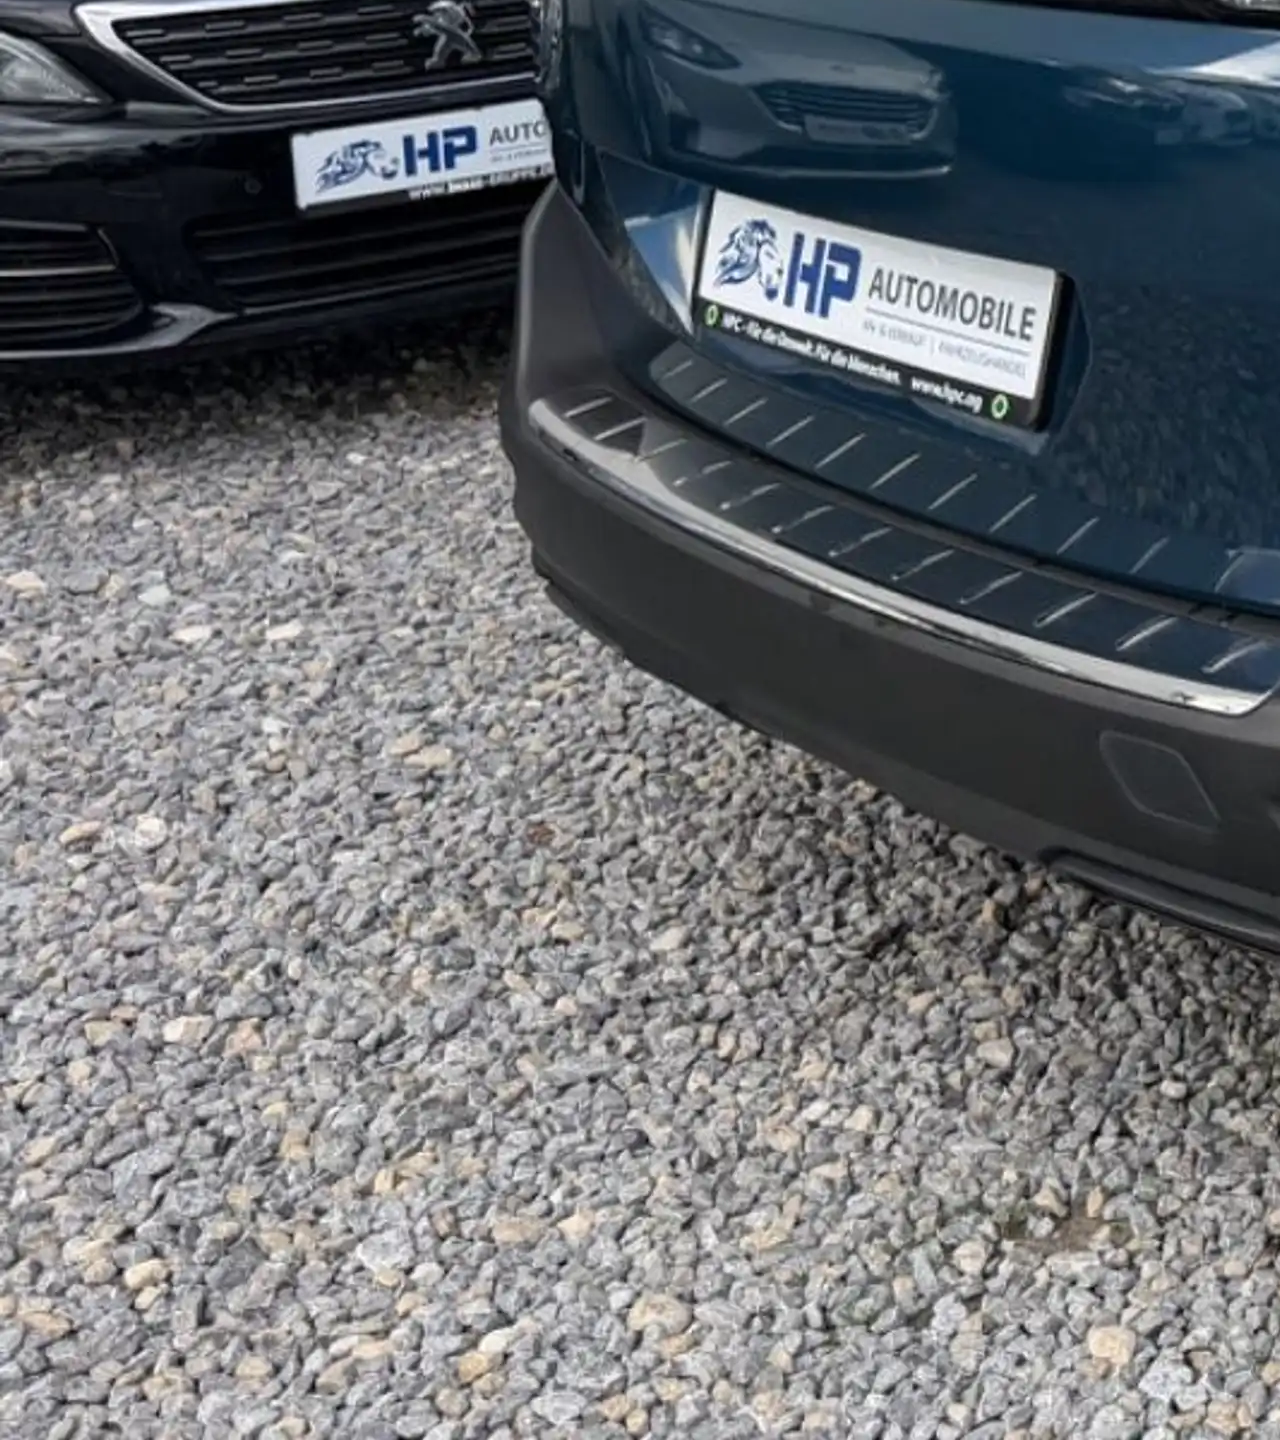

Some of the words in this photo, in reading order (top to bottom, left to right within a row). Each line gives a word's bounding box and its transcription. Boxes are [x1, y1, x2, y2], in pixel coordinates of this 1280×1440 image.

[402, 125, 477, 177] HP
[783, 232, 862, 319] HP
[868, 266, 1037, 342] AUTOMOBILE
